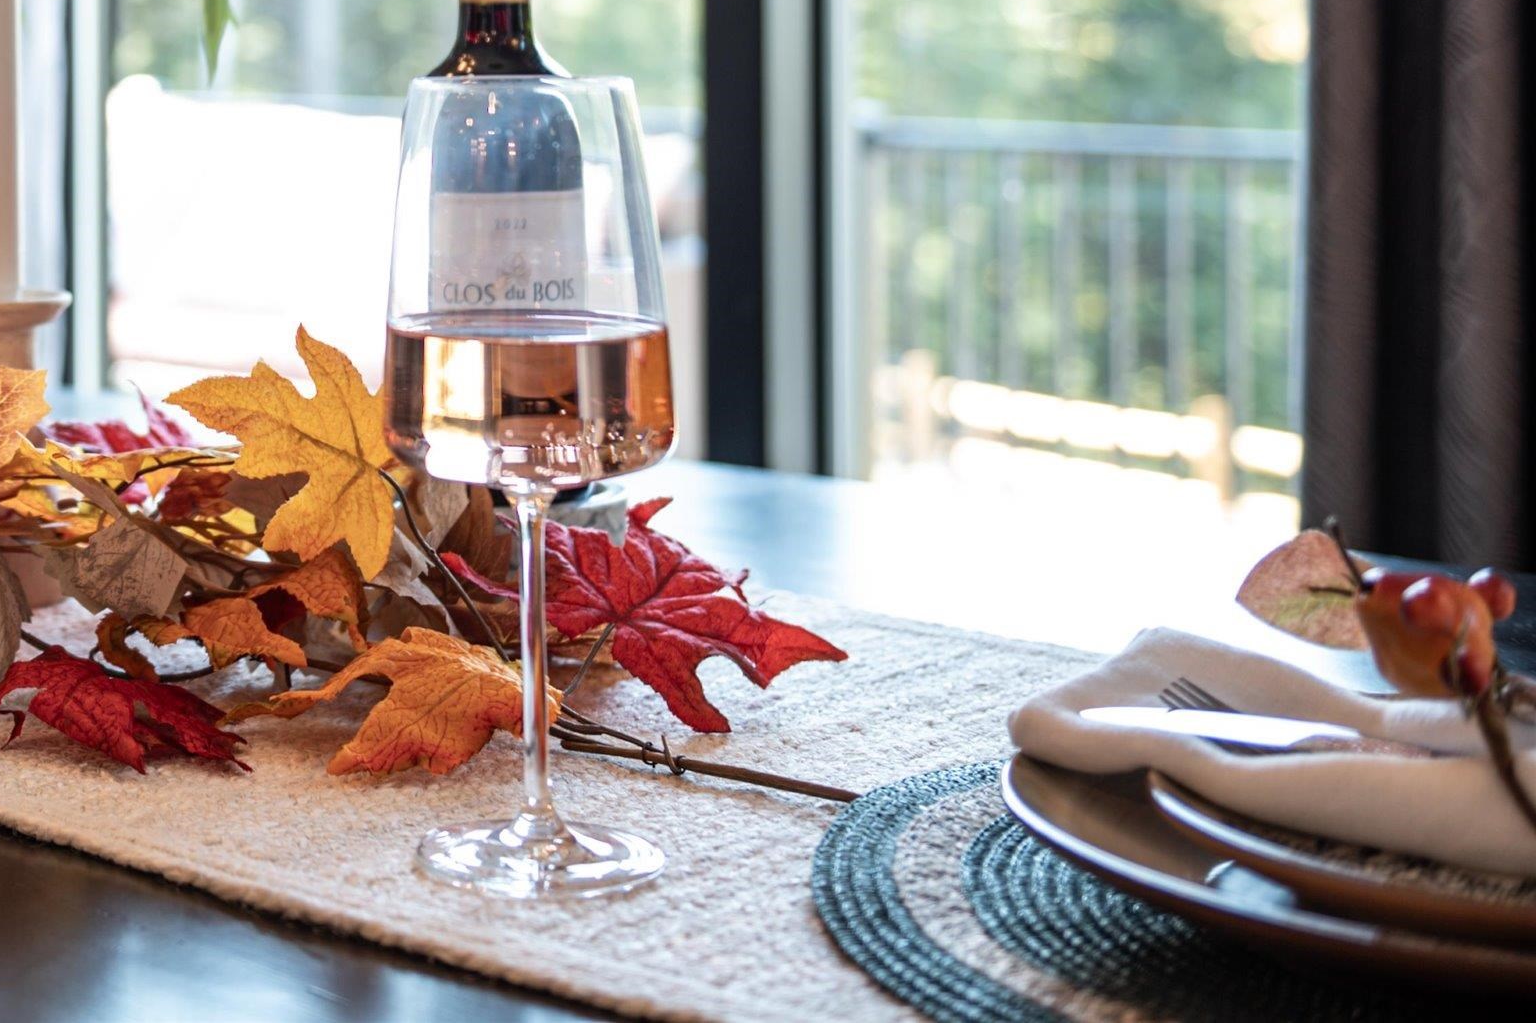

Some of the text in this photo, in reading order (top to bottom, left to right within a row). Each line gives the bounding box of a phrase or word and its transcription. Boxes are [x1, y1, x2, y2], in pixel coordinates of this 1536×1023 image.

[494, 218, 527, 231] 2022
[443, 278, 575, 305] CLOS du BOIS
